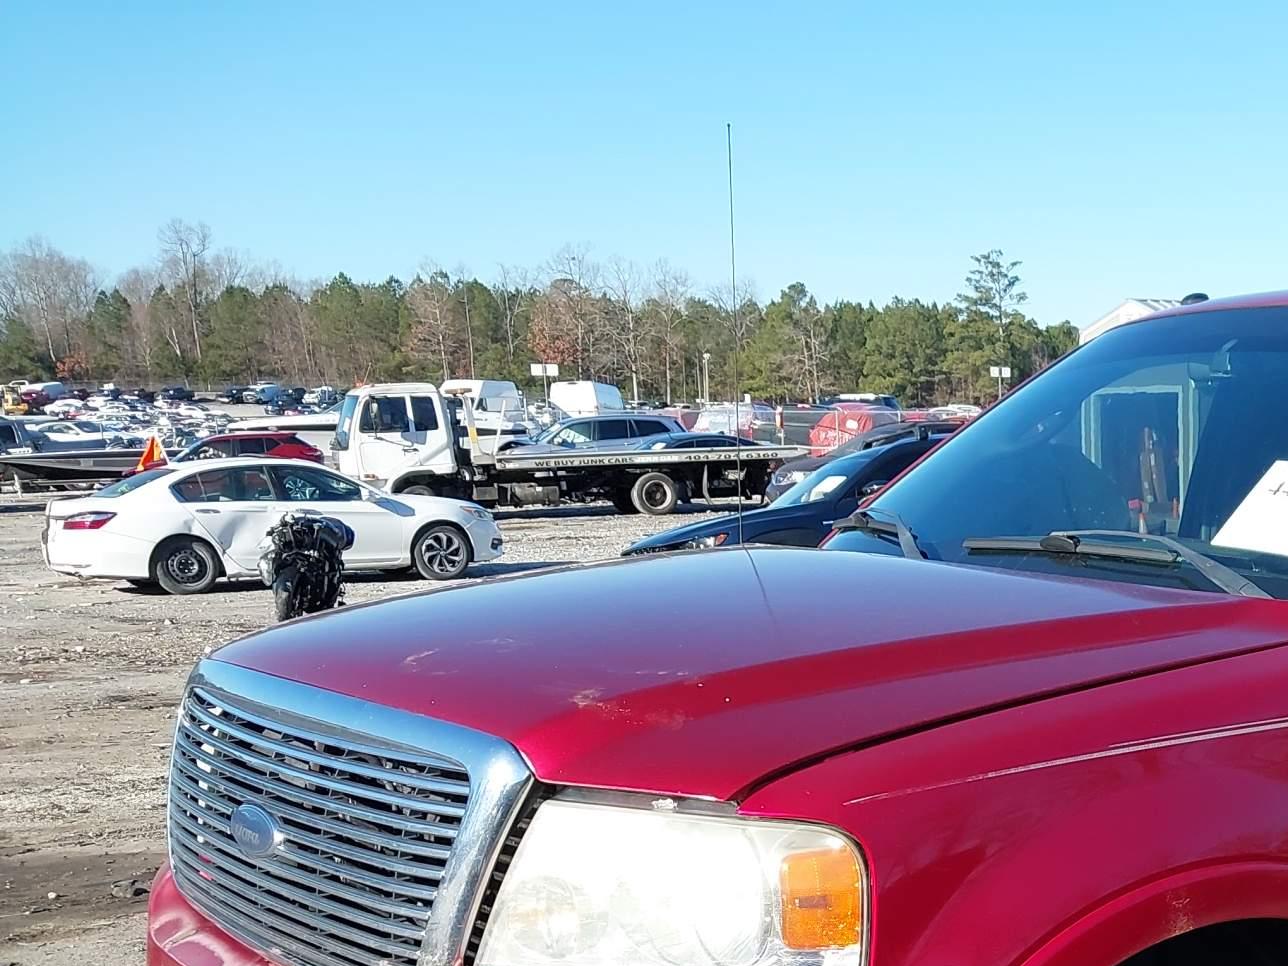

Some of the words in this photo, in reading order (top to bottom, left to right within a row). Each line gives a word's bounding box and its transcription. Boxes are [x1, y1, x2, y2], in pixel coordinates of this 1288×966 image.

[534, 459, 553, 467] WE
[553, 459, 576, 467] BUY
[577, 458, 606, 466] JUNK
[607, 456, 636, 465] CARS
